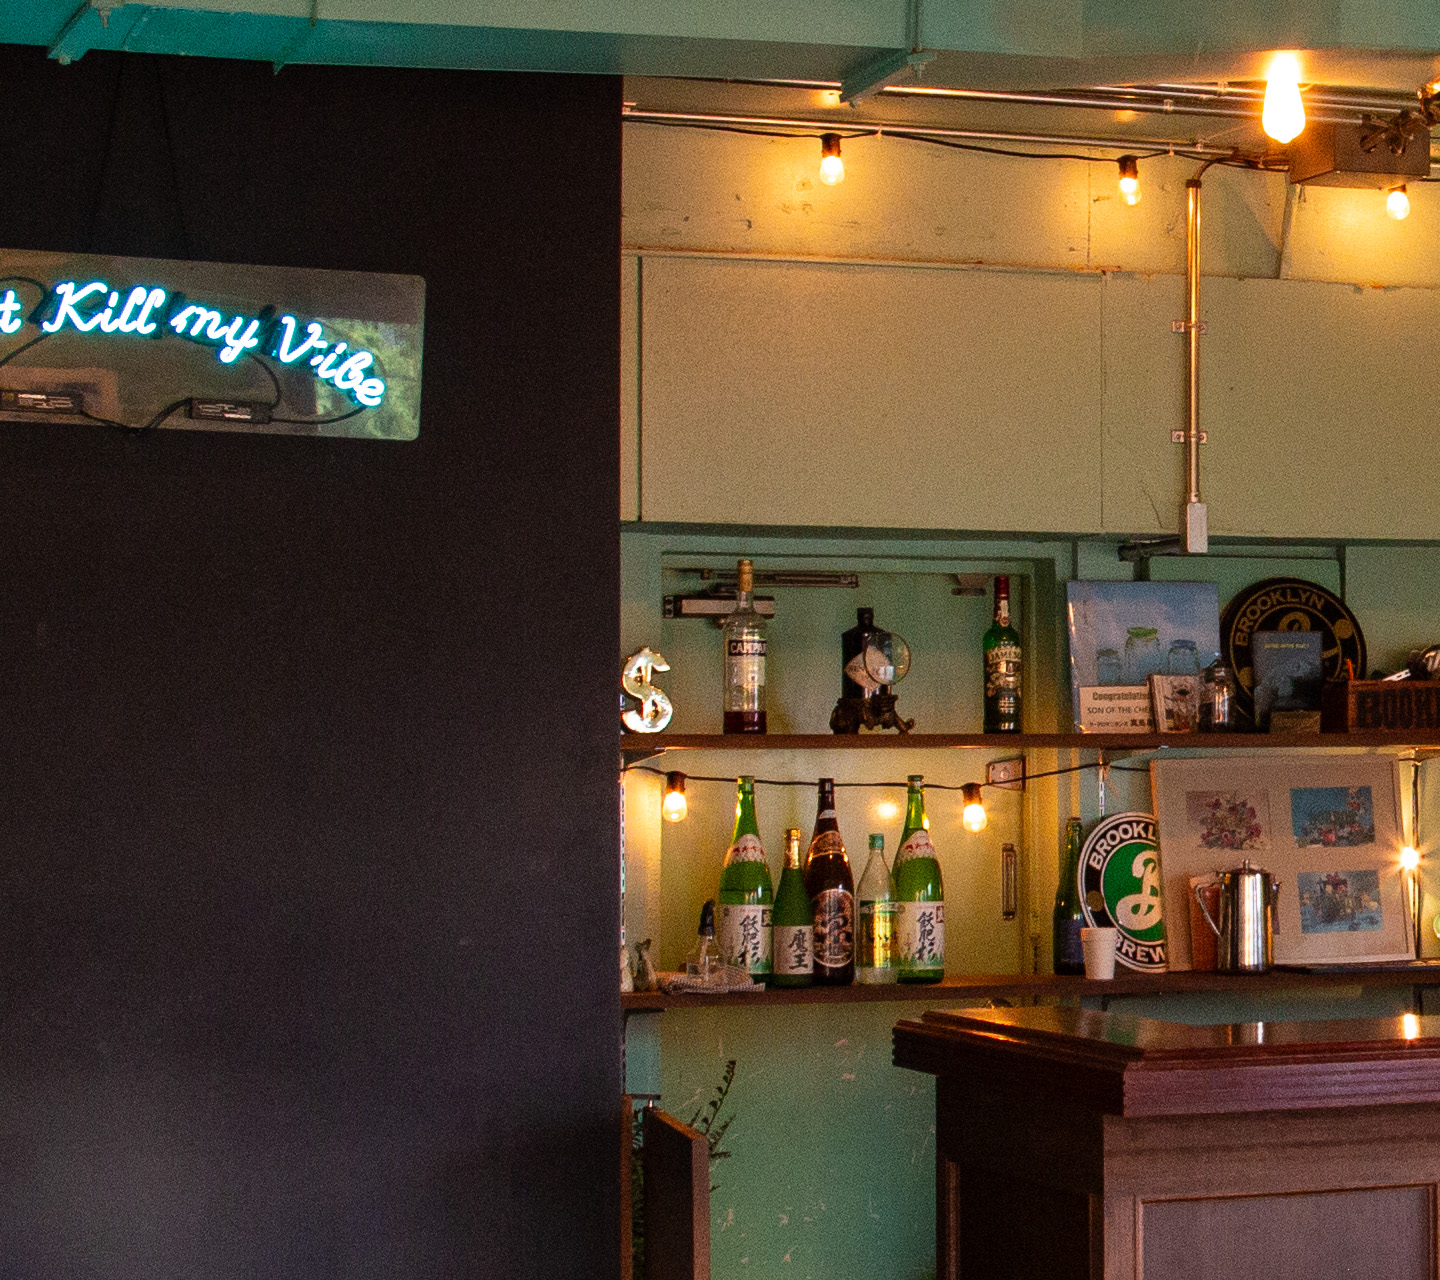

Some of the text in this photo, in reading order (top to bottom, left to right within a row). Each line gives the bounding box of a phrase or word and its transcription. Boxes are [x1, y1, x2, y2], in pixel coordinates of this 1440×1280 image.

[40, 280, 167, 334] Kill
[170, 303, 260, 364] my
[277, 315, 387, 407] Vibe
[1234, 587, 1326, 647] BROOKLYN
[788, 928, 809, 970] 魔王
